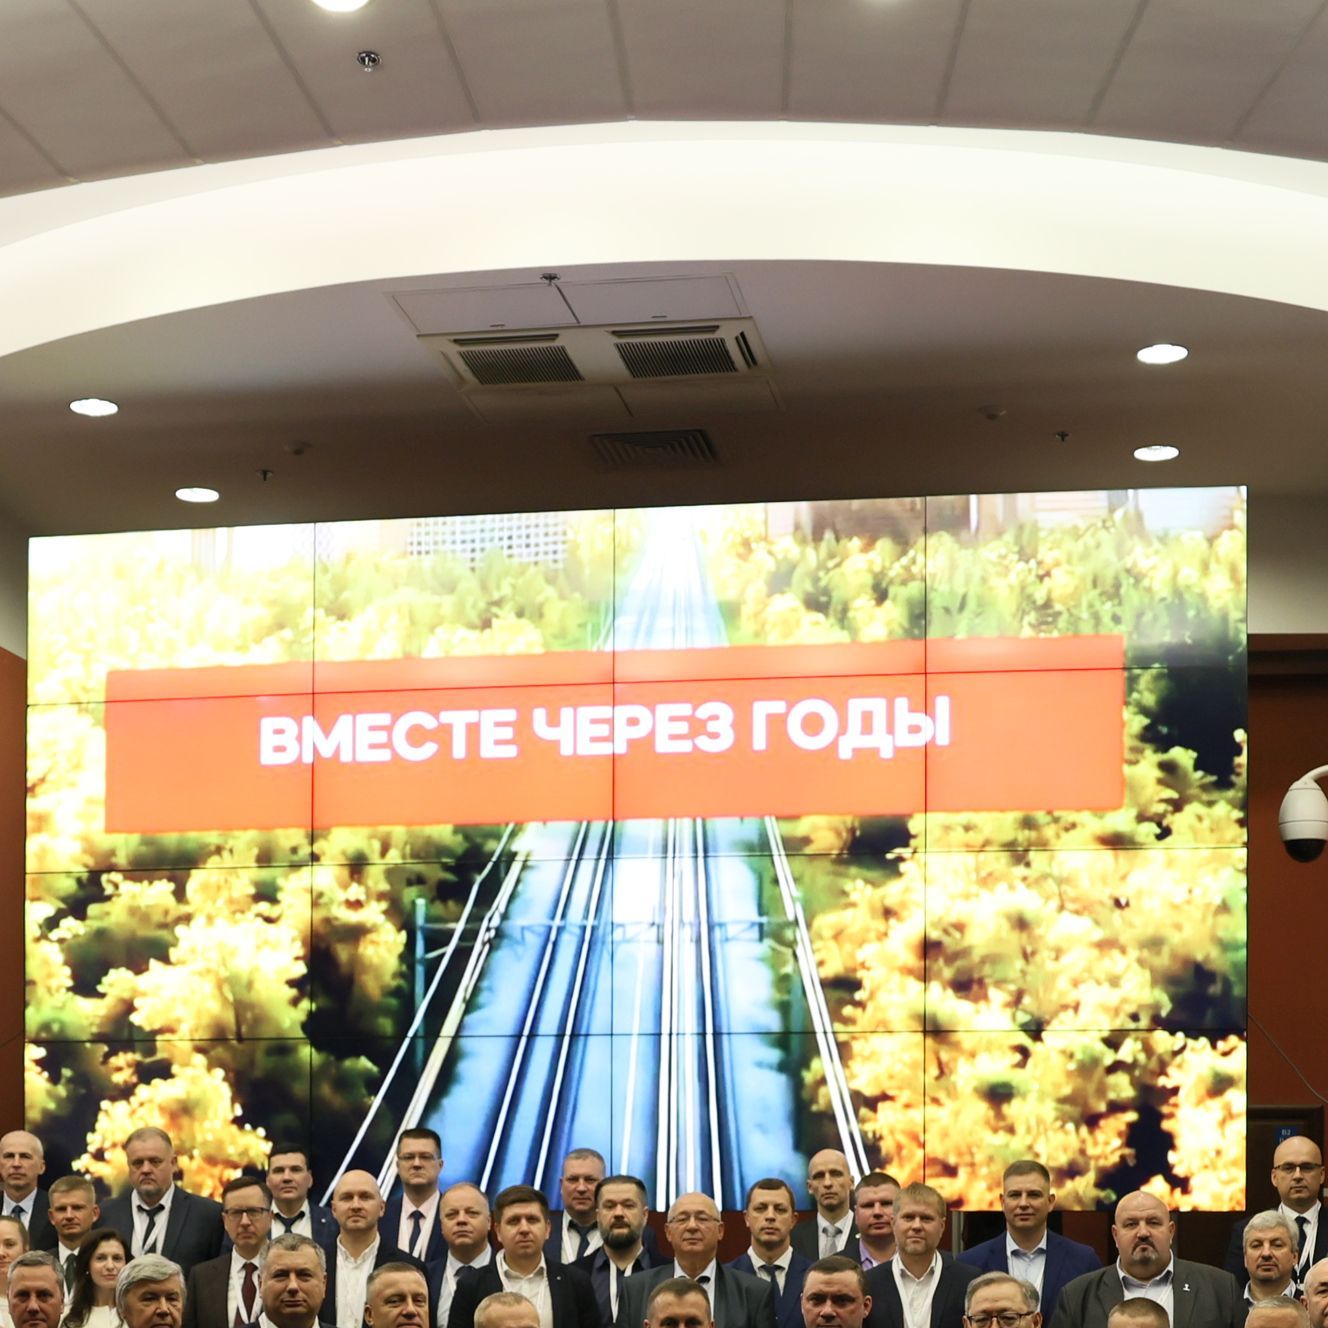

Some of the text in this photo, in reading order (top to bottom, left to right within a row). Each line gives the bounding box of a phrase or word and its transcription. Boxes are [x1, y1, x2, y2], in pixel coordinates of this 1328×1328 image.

[259, 696, 951, 765] ВМЕСТЕ ЧЕРЕЗ ГОДЫ
